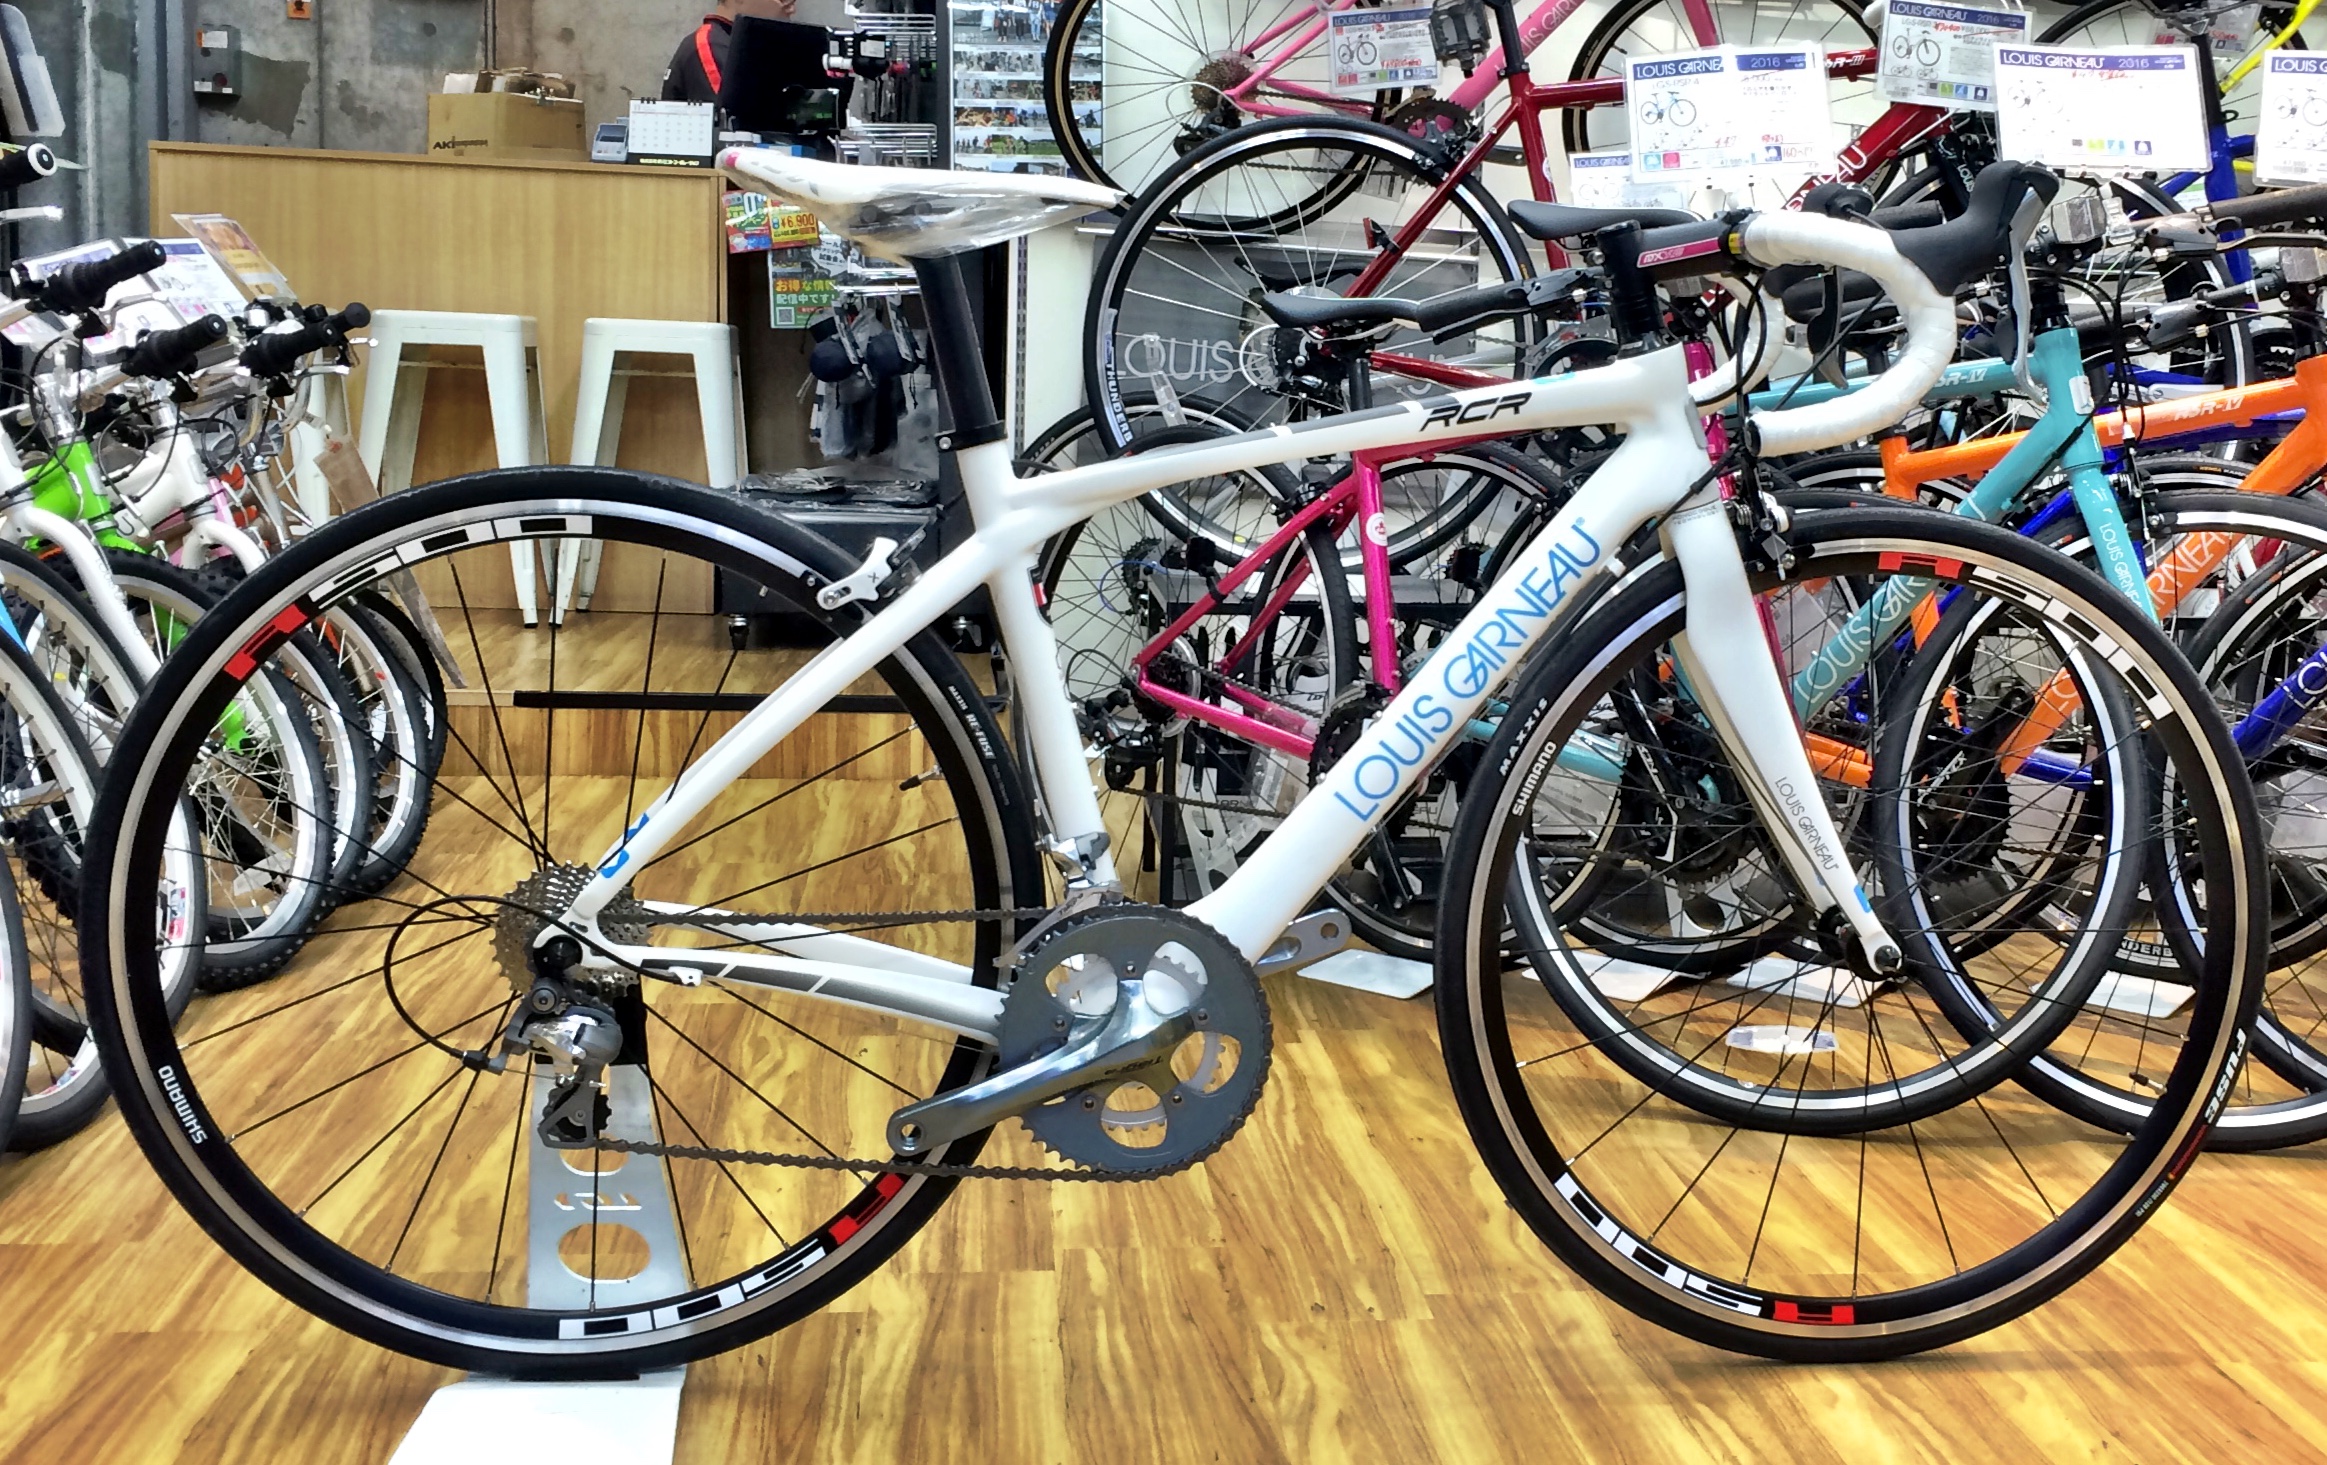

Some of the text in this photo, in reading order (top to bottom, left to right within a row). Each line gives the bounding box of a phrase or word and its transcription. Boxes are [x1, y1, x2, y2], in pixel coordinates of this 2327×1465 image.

[1893, 4, 1922, 16] LOUIS
[1636, 63, 1676, 79] LOUIS
[1751, 57, 1781, 68] 2016
[2003, 52, 2041, 66] LOUIS
[2045, 55, 2105, 69] GARNEAU
[2118, 58, 2149, 68] 2016
[2274, 60, 2317, 72] LOUIS
[1105, 347, 1135, 444] THUNDERB
[1419, 391, 1533, 432] RCR
[2099, 522, 2124, 562] LOUIS
[1794, 616, 1872, 703] LOUIS
[1334, 694, 1454, 823] LOUIS
[1500, 697, 1548, 776] MAXXIS
[1512, 741, 1557, 817] SHIMANO
[1774, 776, 1840, 871] LOUIS GARNEAU
[158, 1065, 208, 1145] SHIMANO
[2203, 1027, 2247, 1125] FUSE
